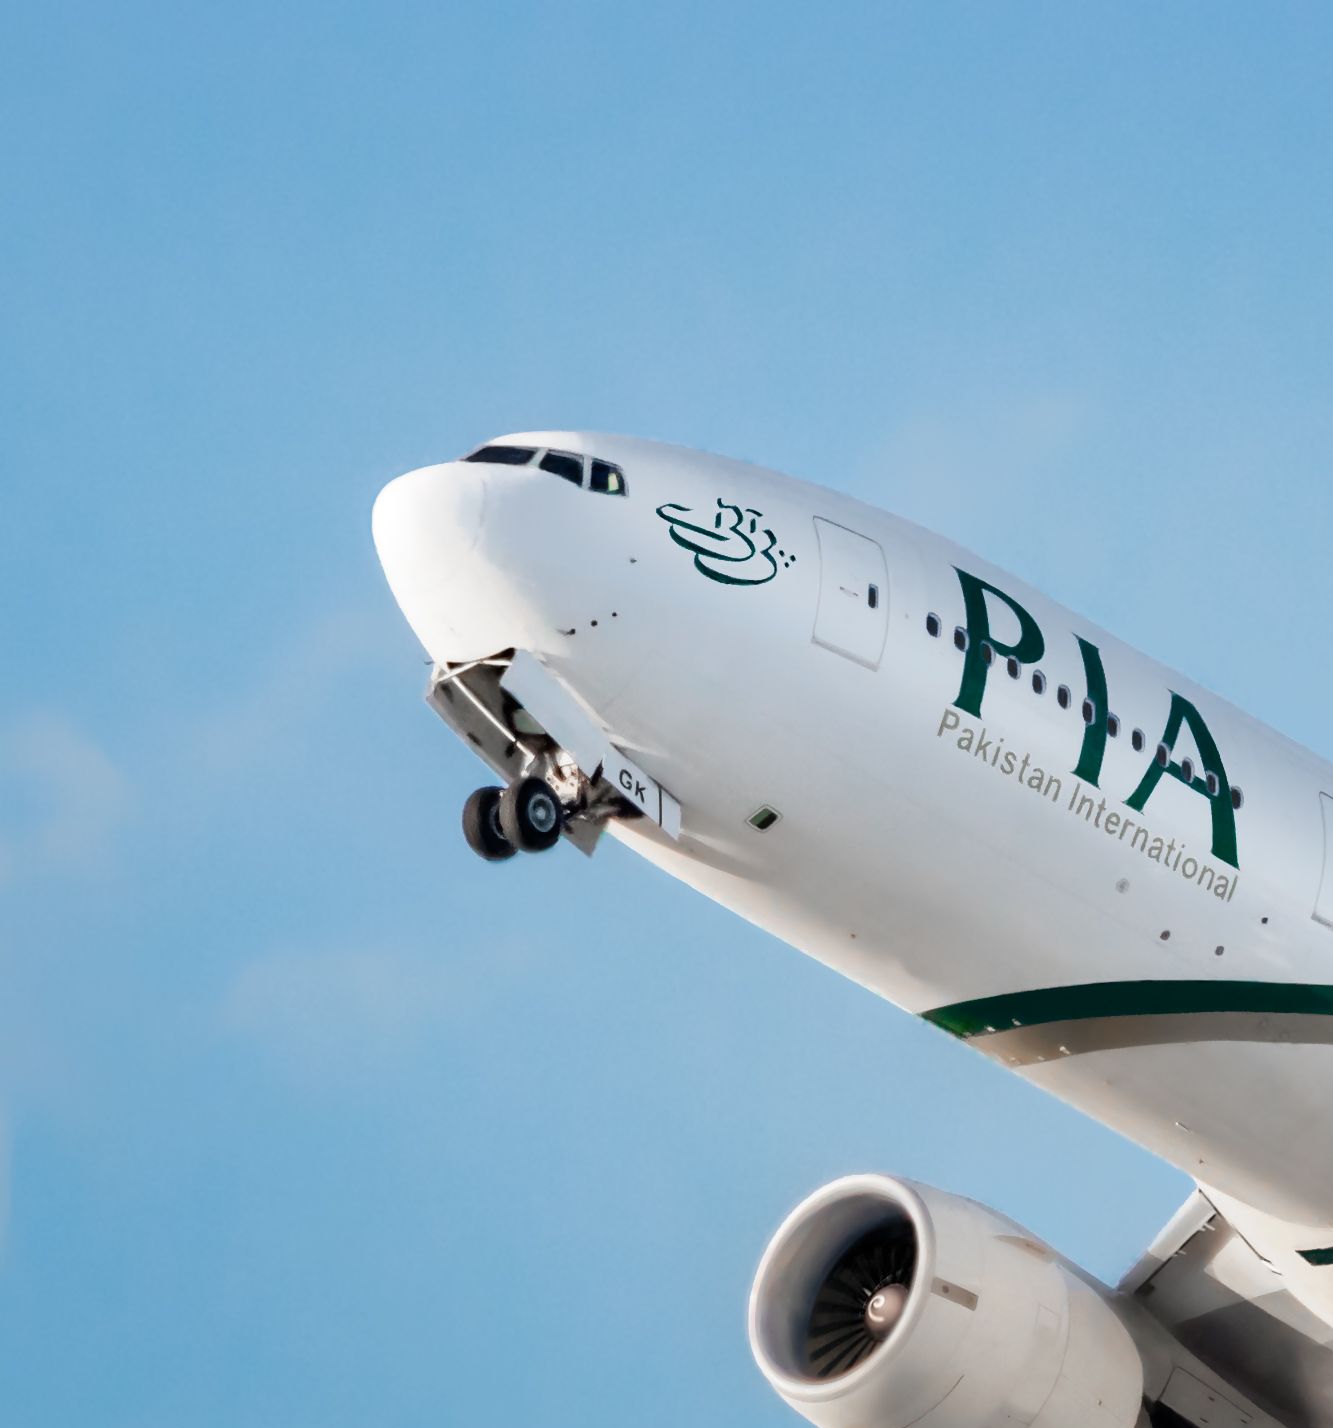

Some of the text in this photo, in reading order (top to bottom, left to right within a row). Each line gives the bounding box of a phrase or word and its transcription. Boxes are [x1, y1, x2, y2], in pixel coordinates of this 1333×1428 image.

[619, 769, 646, 804] GK
[937, 708, 1239, 902] Pakistan International
[951, 565, 1239, 870] PIA
